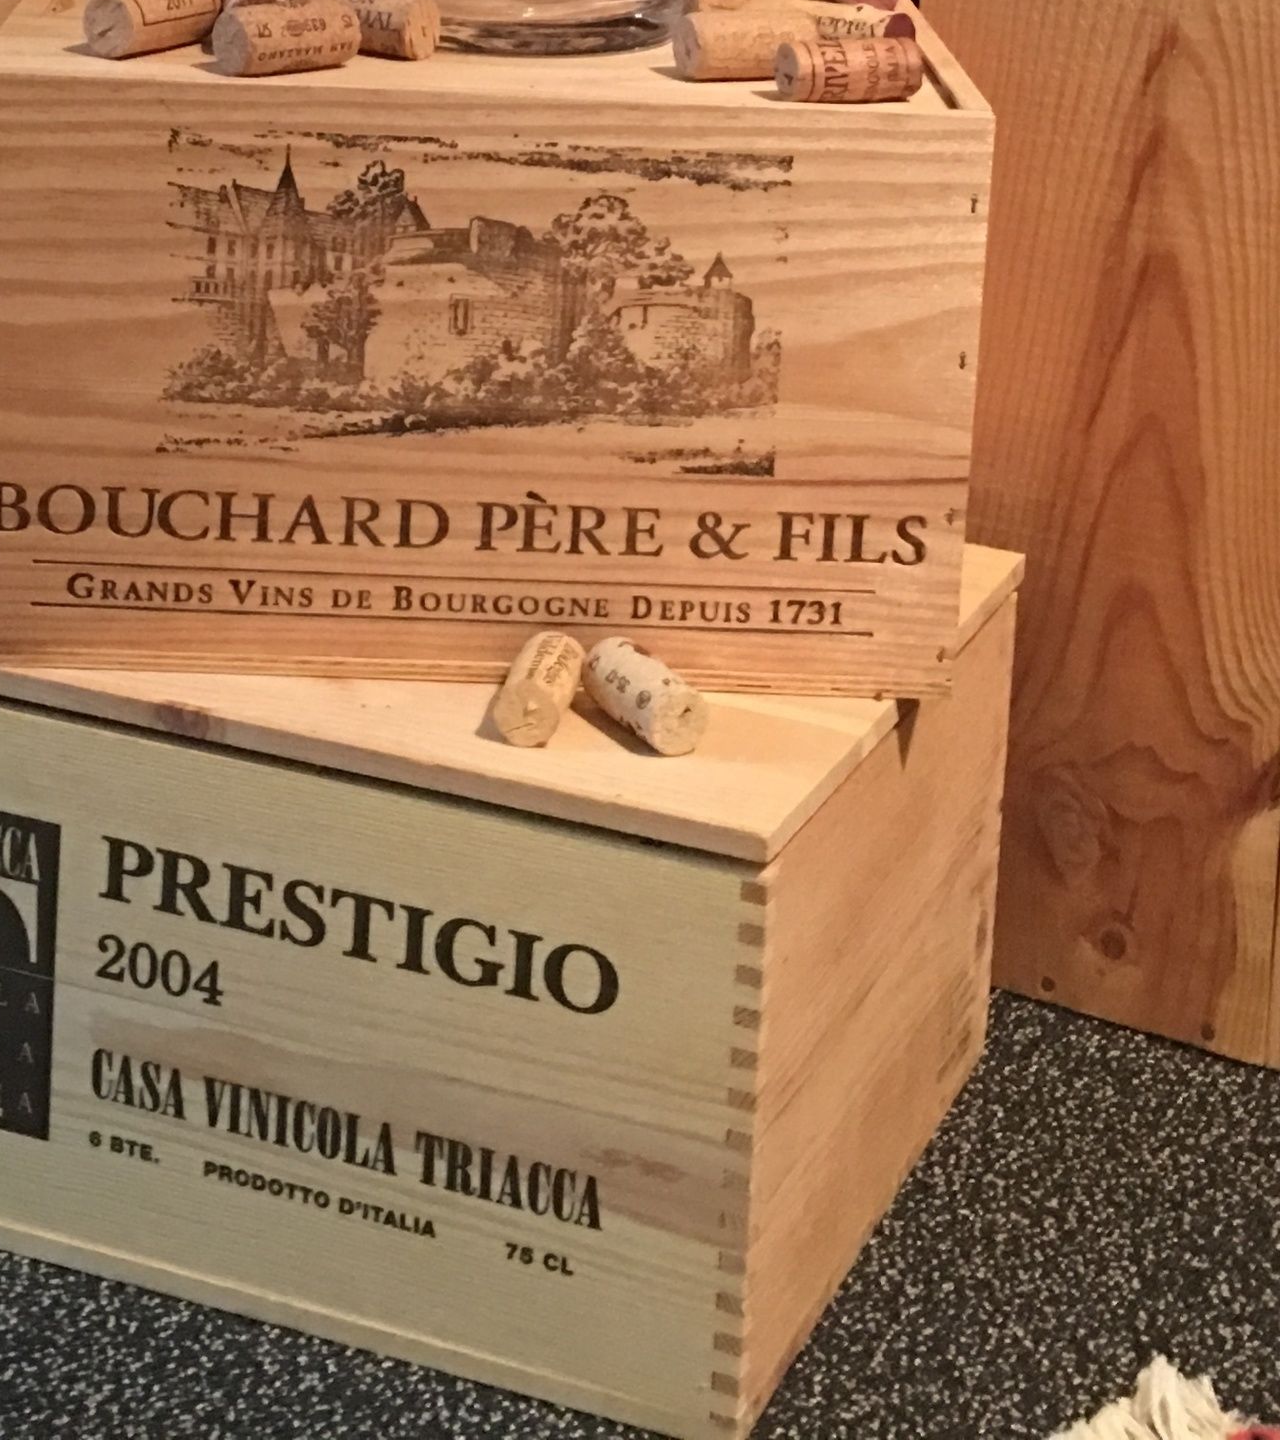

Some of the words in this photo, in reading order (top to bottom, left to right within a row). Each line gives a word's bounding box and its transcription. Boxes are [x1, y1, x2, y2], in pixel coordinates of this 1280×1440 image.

[475, 491, 665, 557] PÈRE
[689, 510, 753, 561] &
[771, 510, 929, 566] FILS
[331, 588, 373, 610] DE
[768, 599, 844, 626] 1731
[98, 834, 621, 1015] PRESTIGIO
[95, 933, 224, 1007] 2004
[88, 1130, 103, 1148] 6
[109, 1136, 160, 1165] BTE.
[90, 1046, 187, 1121] CASA
[202, 1074, 399, 1177] VINICOLA
[415, 1129, 603, 1232] TRIACCA
[202, 1160, 331, 1210] PRODOTTO
[338, 1197, 437, 1239] D'ITALIA
[504, 1242, 534, 1266] 75
[541, 1251, 574, 1277] CL
